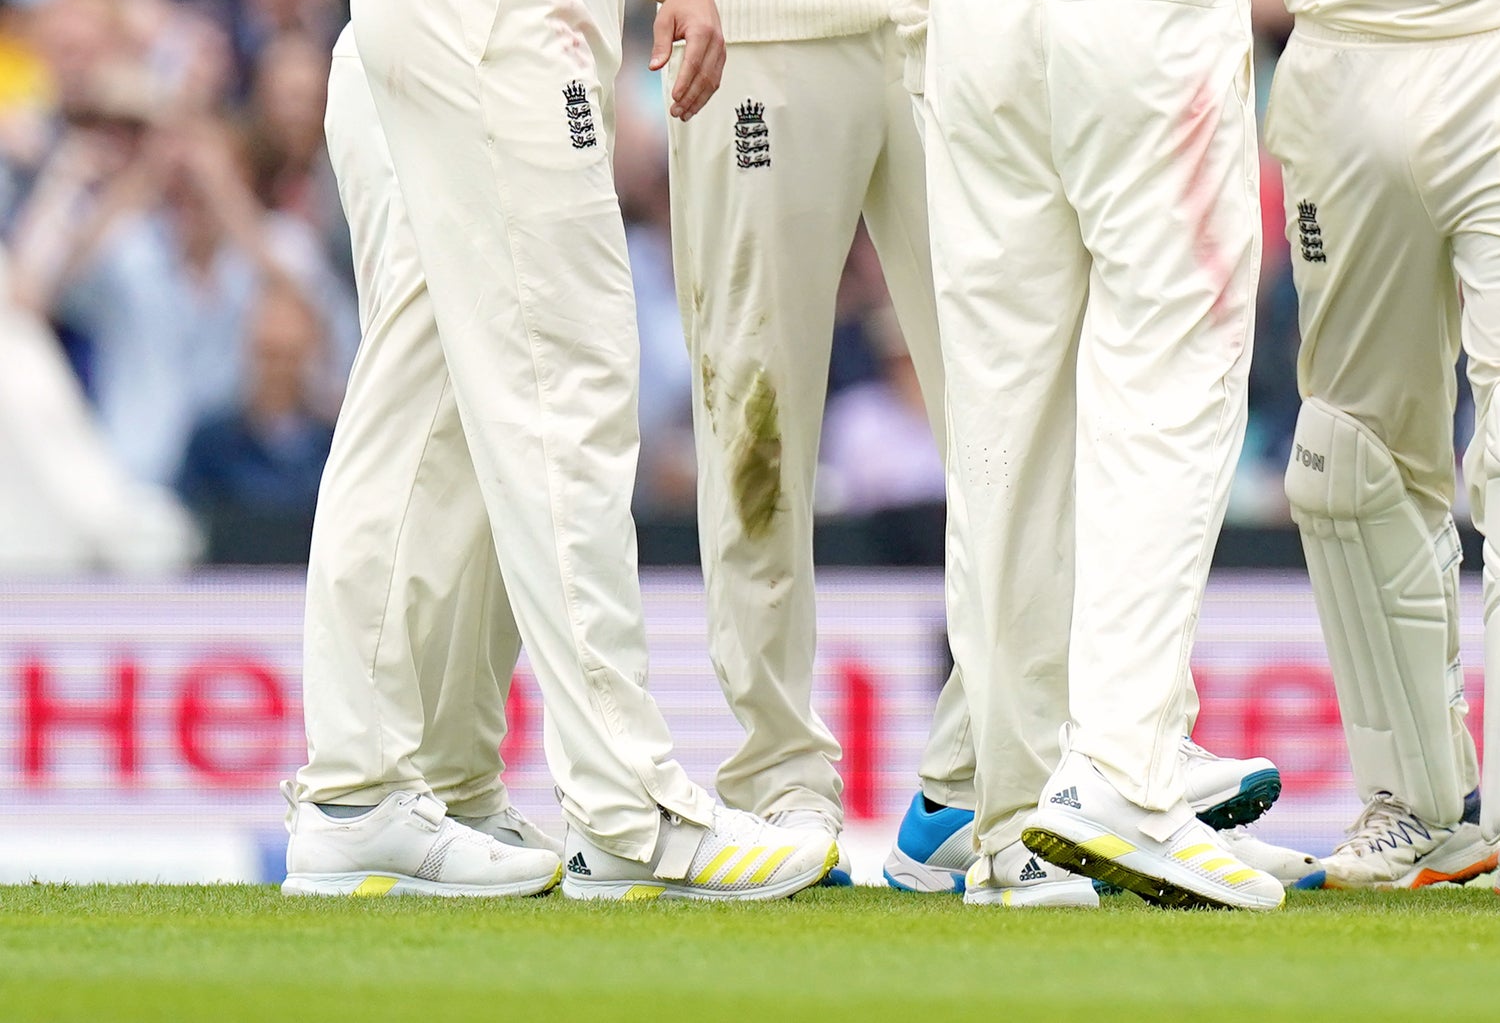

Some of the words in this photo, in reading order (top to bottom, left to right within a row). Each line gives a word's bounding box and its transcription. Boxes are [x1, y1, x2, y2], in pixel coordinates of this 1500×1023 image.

[1296, 443, 1325, 473] TON
[1050, 796, 1081, 809] adidas
[1019, 870, 1048, 882] adidas
